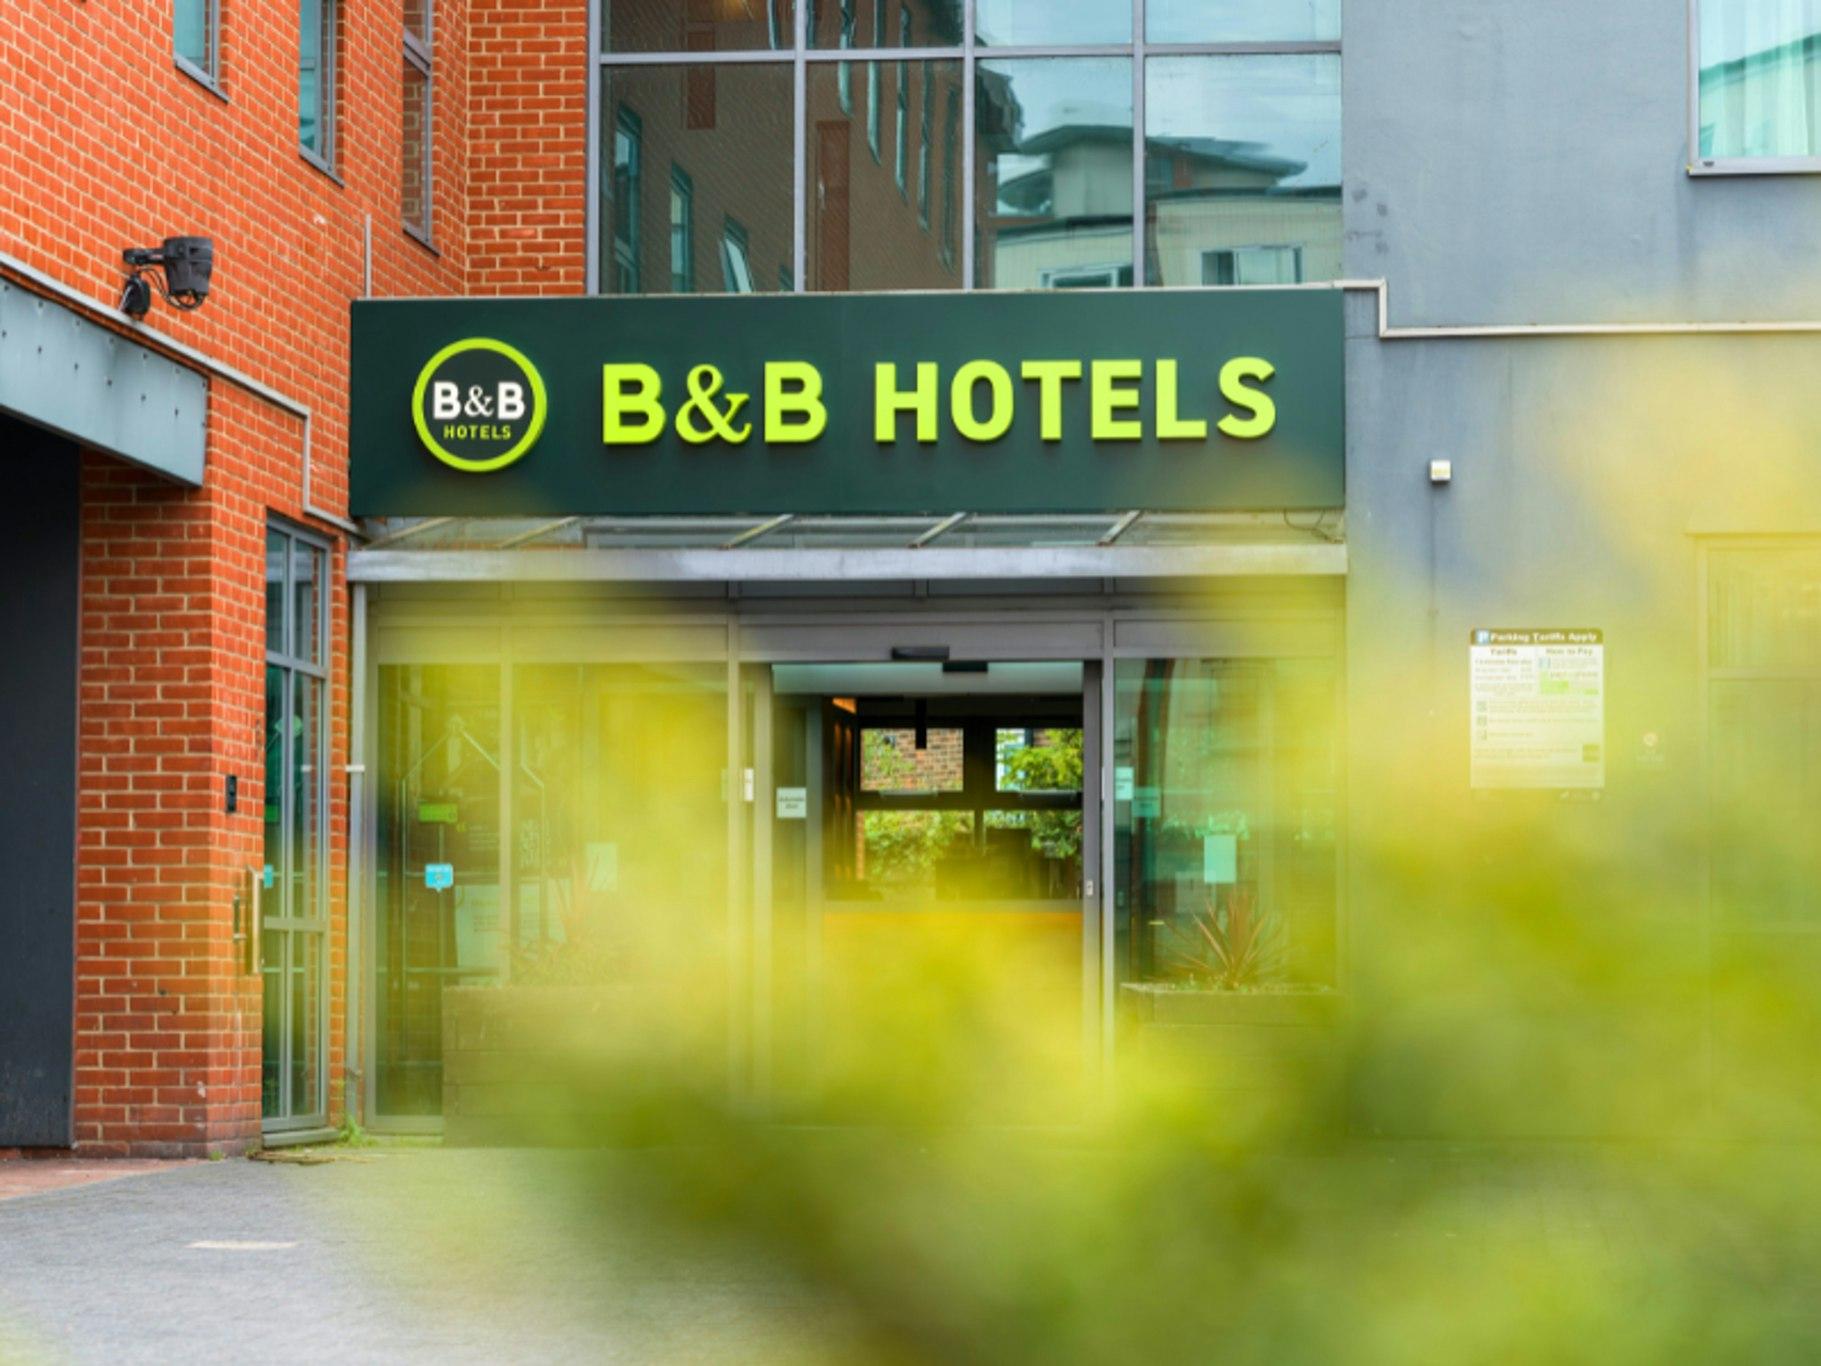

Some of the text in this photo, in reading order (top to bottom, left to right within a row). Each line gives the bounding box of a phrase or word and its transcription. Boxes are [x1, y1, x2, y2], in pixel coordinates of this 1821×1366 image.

[433, 381, 525, 420] B&B
[603, 357, 1277, 444] B&B HOTELS
[443, 425, 512, 440] HOTELS
[1491, 632, 1530, 643] Parking
[1533, 632, 1565, 642] Tariffs
[1568, 632, 1597, 643] Apply
